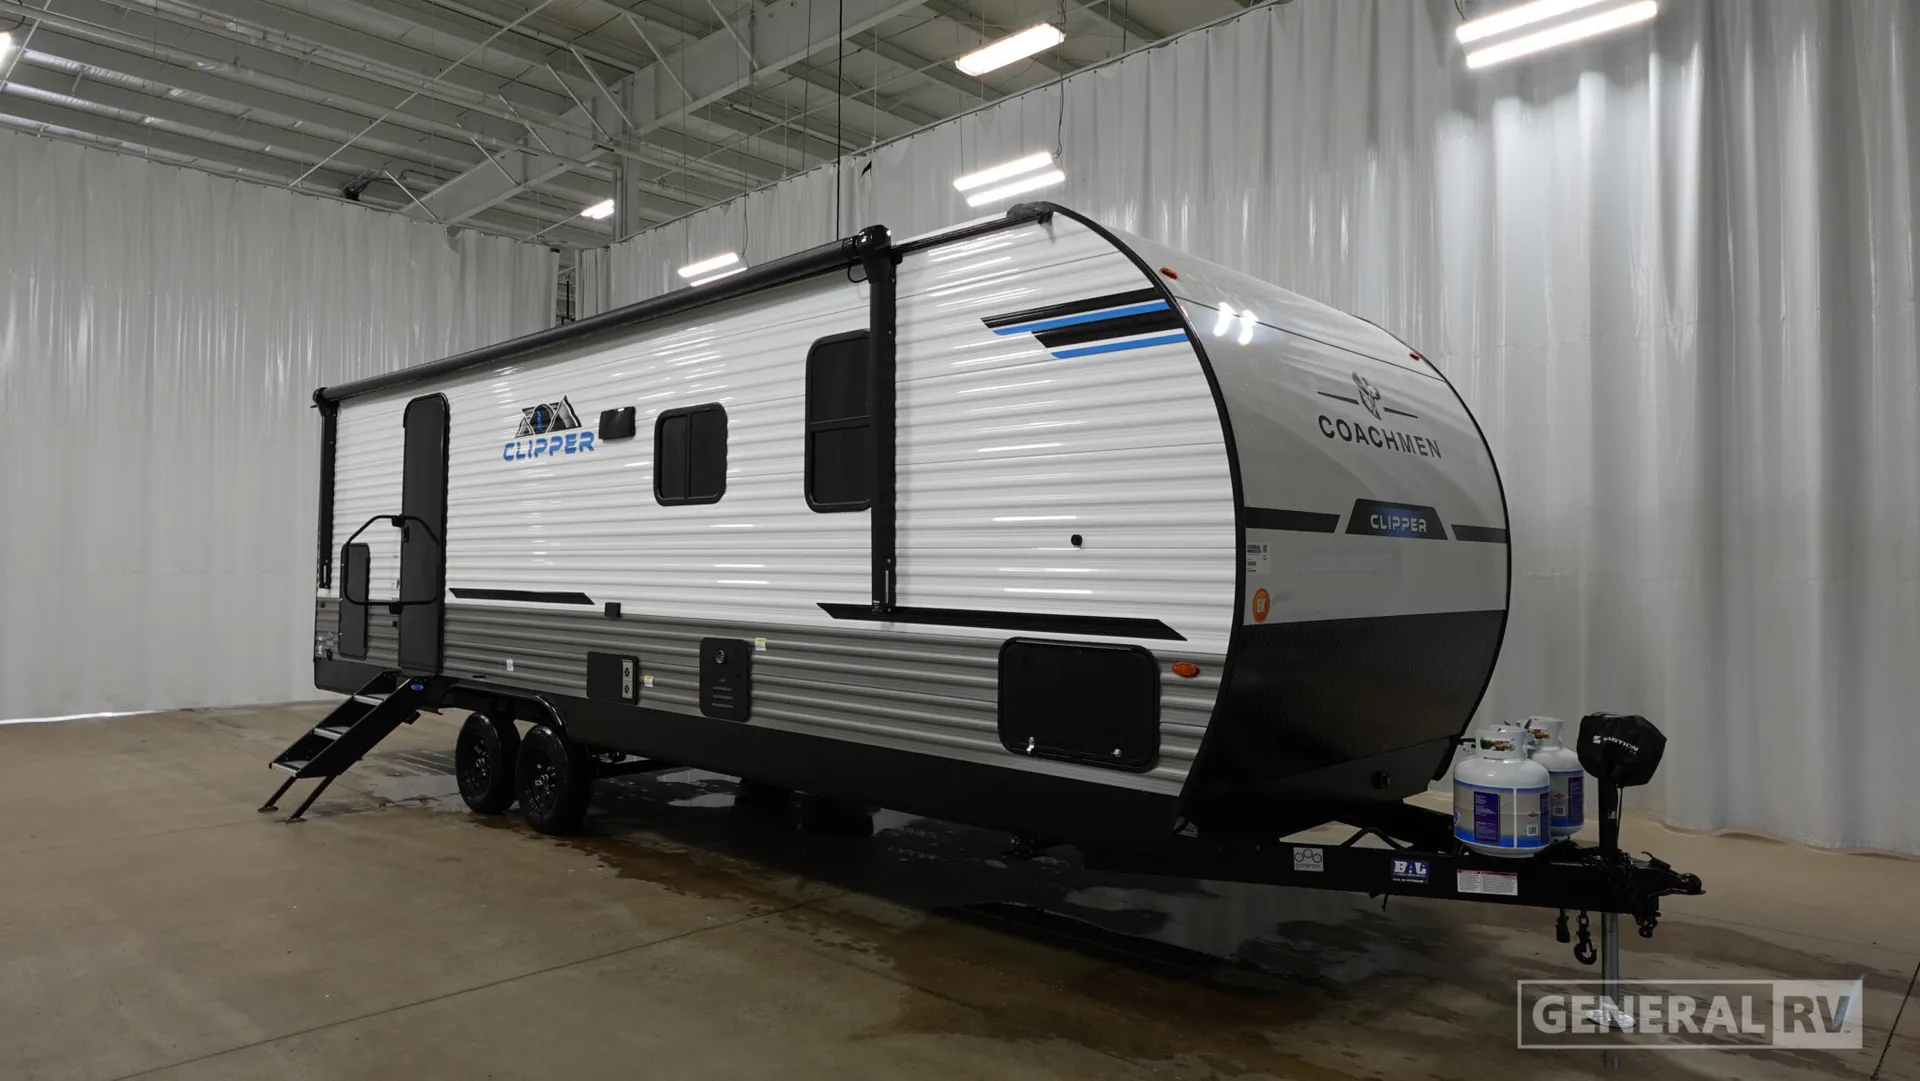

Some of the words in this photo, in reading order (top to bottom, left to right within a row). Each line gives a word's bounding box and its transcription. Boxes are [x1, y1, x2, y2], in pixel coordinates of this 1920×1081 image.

[503, 431, 595, 461] CLIPPER
[1318, 414, 1442, 459] COACHMEN
[1370, 513, 1427, 533] CLIPPER
